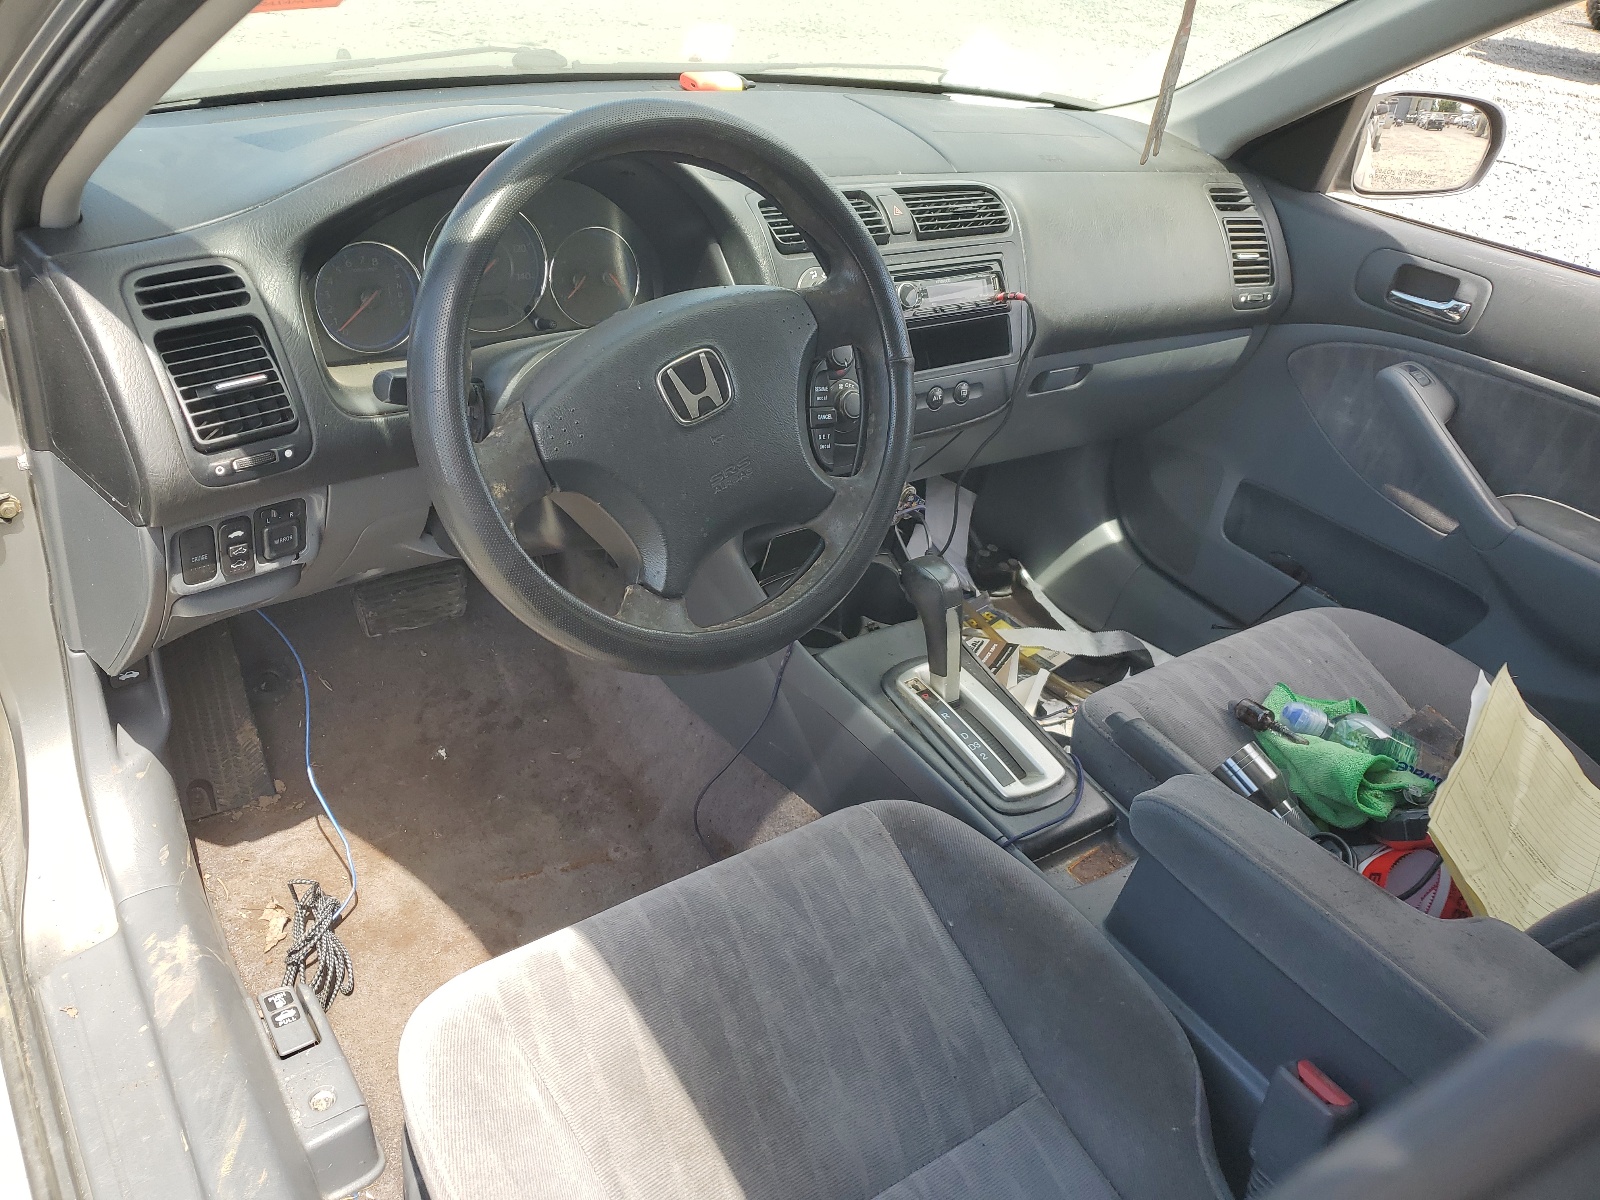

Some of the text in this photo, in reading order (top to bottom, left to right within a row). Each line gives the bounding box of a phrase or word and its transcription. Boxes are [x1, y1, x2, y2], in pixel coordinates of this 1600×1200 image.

[516, 272, 531, 281] 140
[710, 456, 750, 482] SRS
[273, 534, 293, 545] MIRROR
[191, 553, 209, 563] CRUISE
[941, 712, 950, 720] R
[960, 732, 969, 740] D
[980, 752, 989, 761] 2
[278, 1017, 297, 1027] PULL
